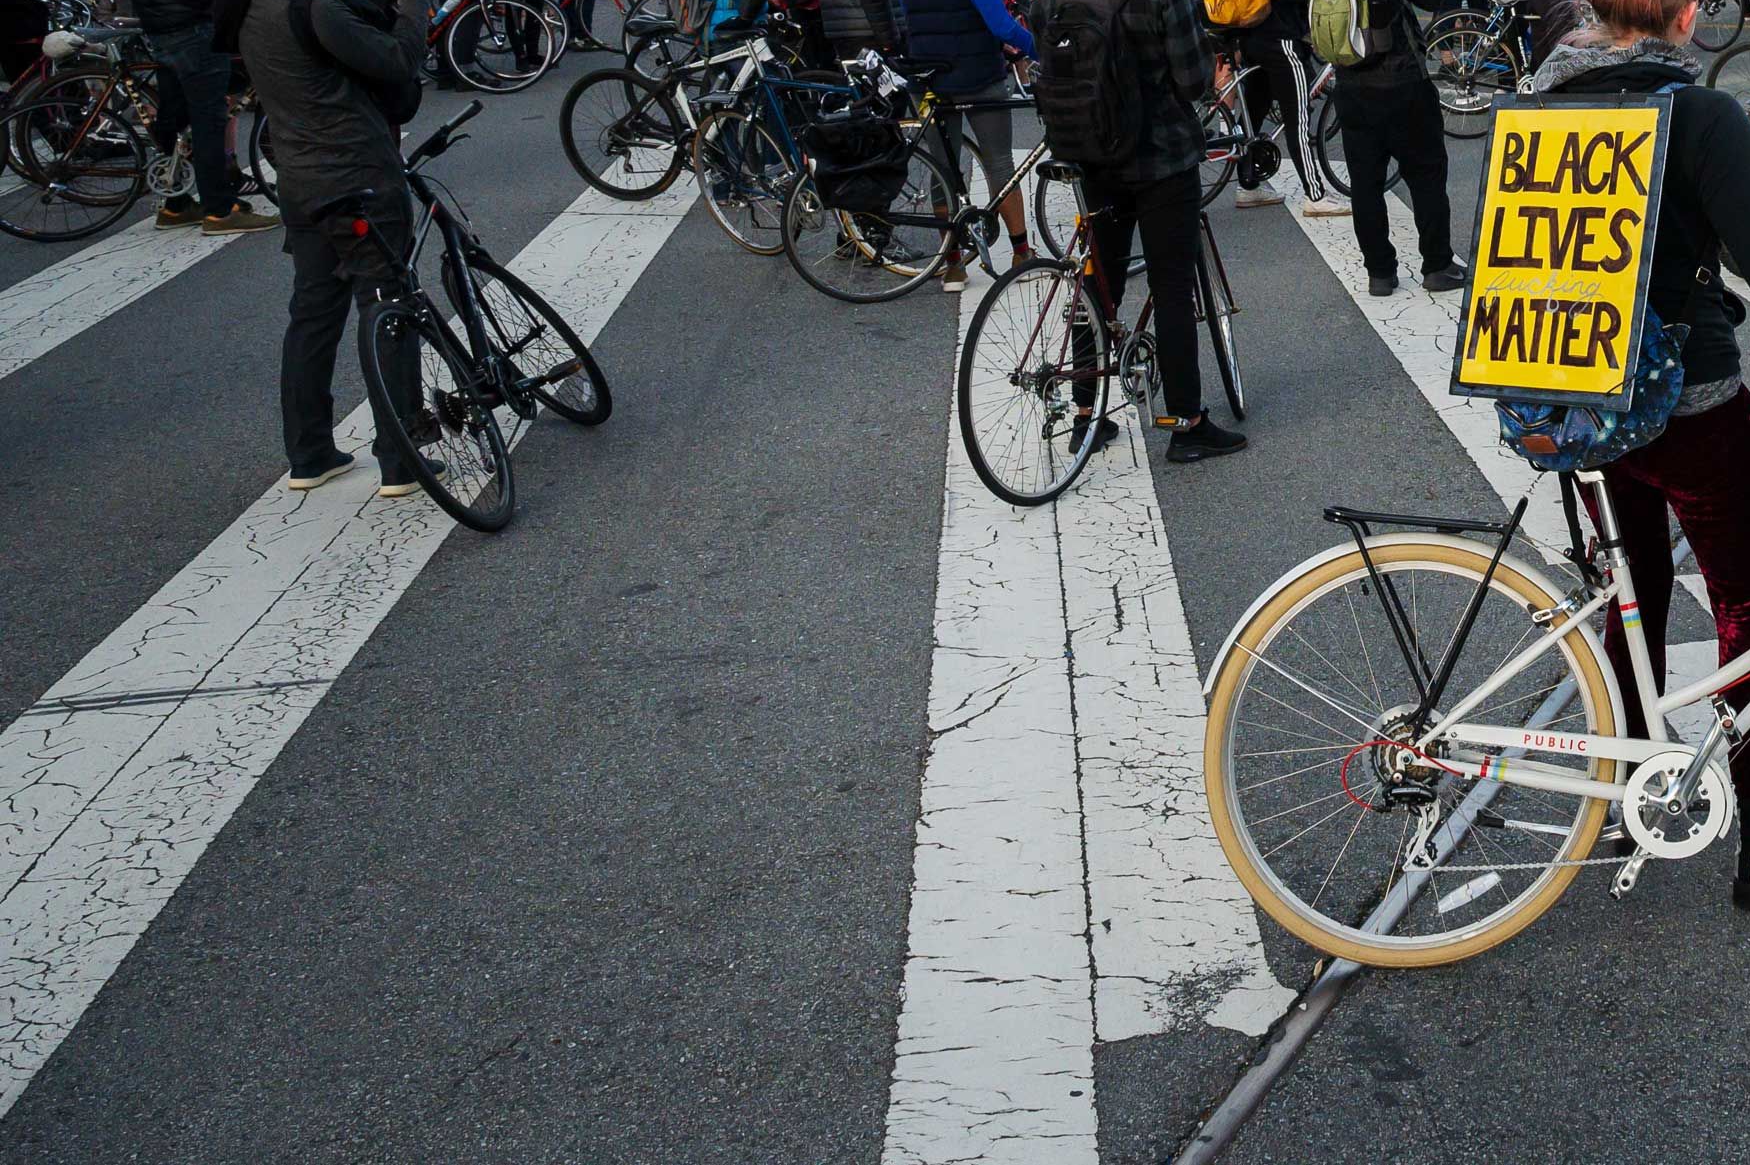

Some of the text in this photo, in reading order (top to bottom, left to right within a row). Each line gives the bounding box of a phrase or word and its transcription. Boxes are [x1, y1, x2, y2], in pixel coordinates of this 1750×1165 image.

[1498, 131, 1652, 197] BLACK
[1487, 206, 1642, 274] LIVES
[1466, 296, 1622, 370] MATTER
[1523, 733, 1588, 752] PUBLIC
